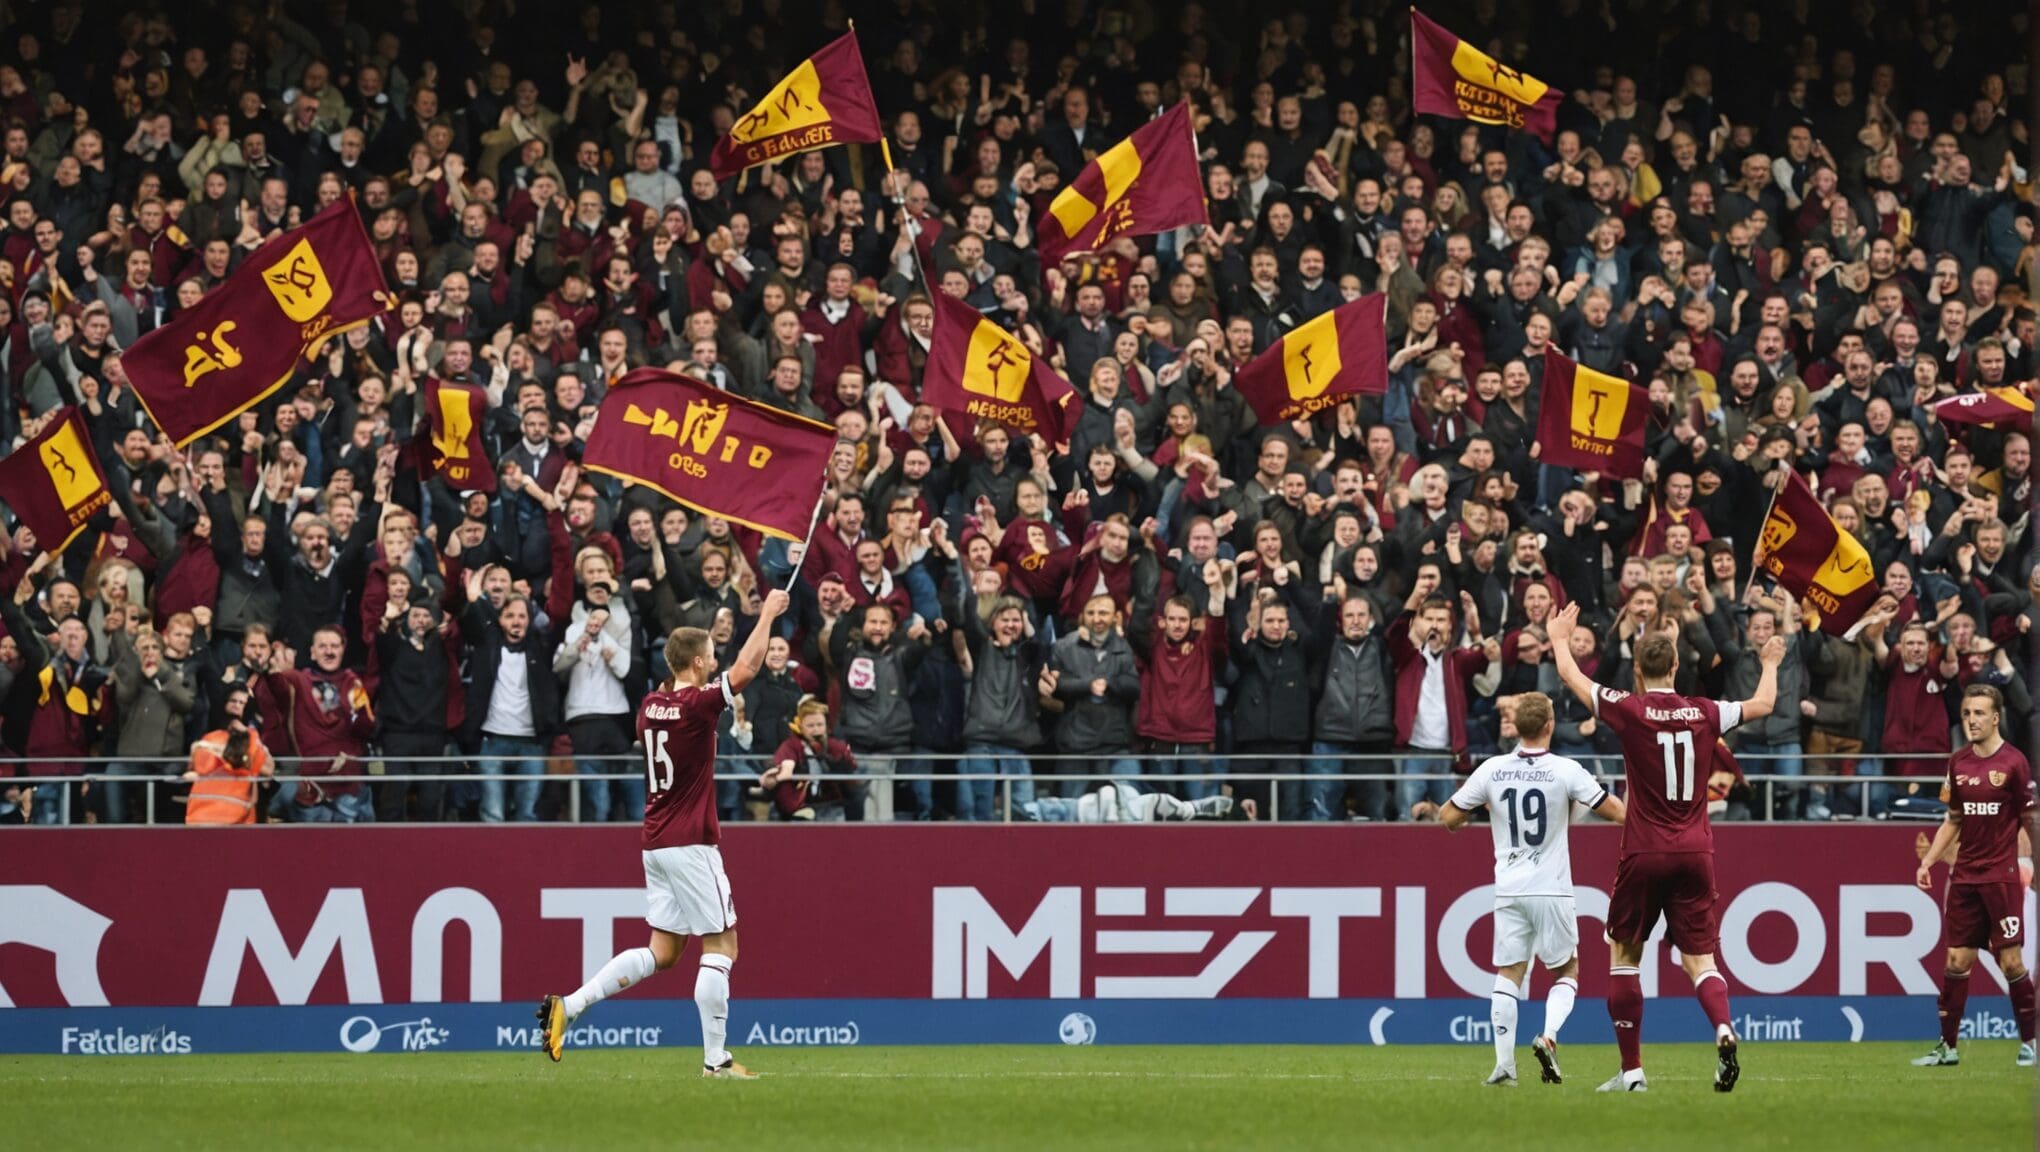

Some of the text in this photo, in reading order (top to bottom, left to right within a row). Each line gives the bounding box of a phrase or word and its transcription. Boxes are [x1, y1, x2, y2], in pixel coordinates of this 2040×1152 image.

[644, 728, 674, 793] 15
[1656, 730, 1695, 801] 11
[1500, 787, 1547, 848] 19
